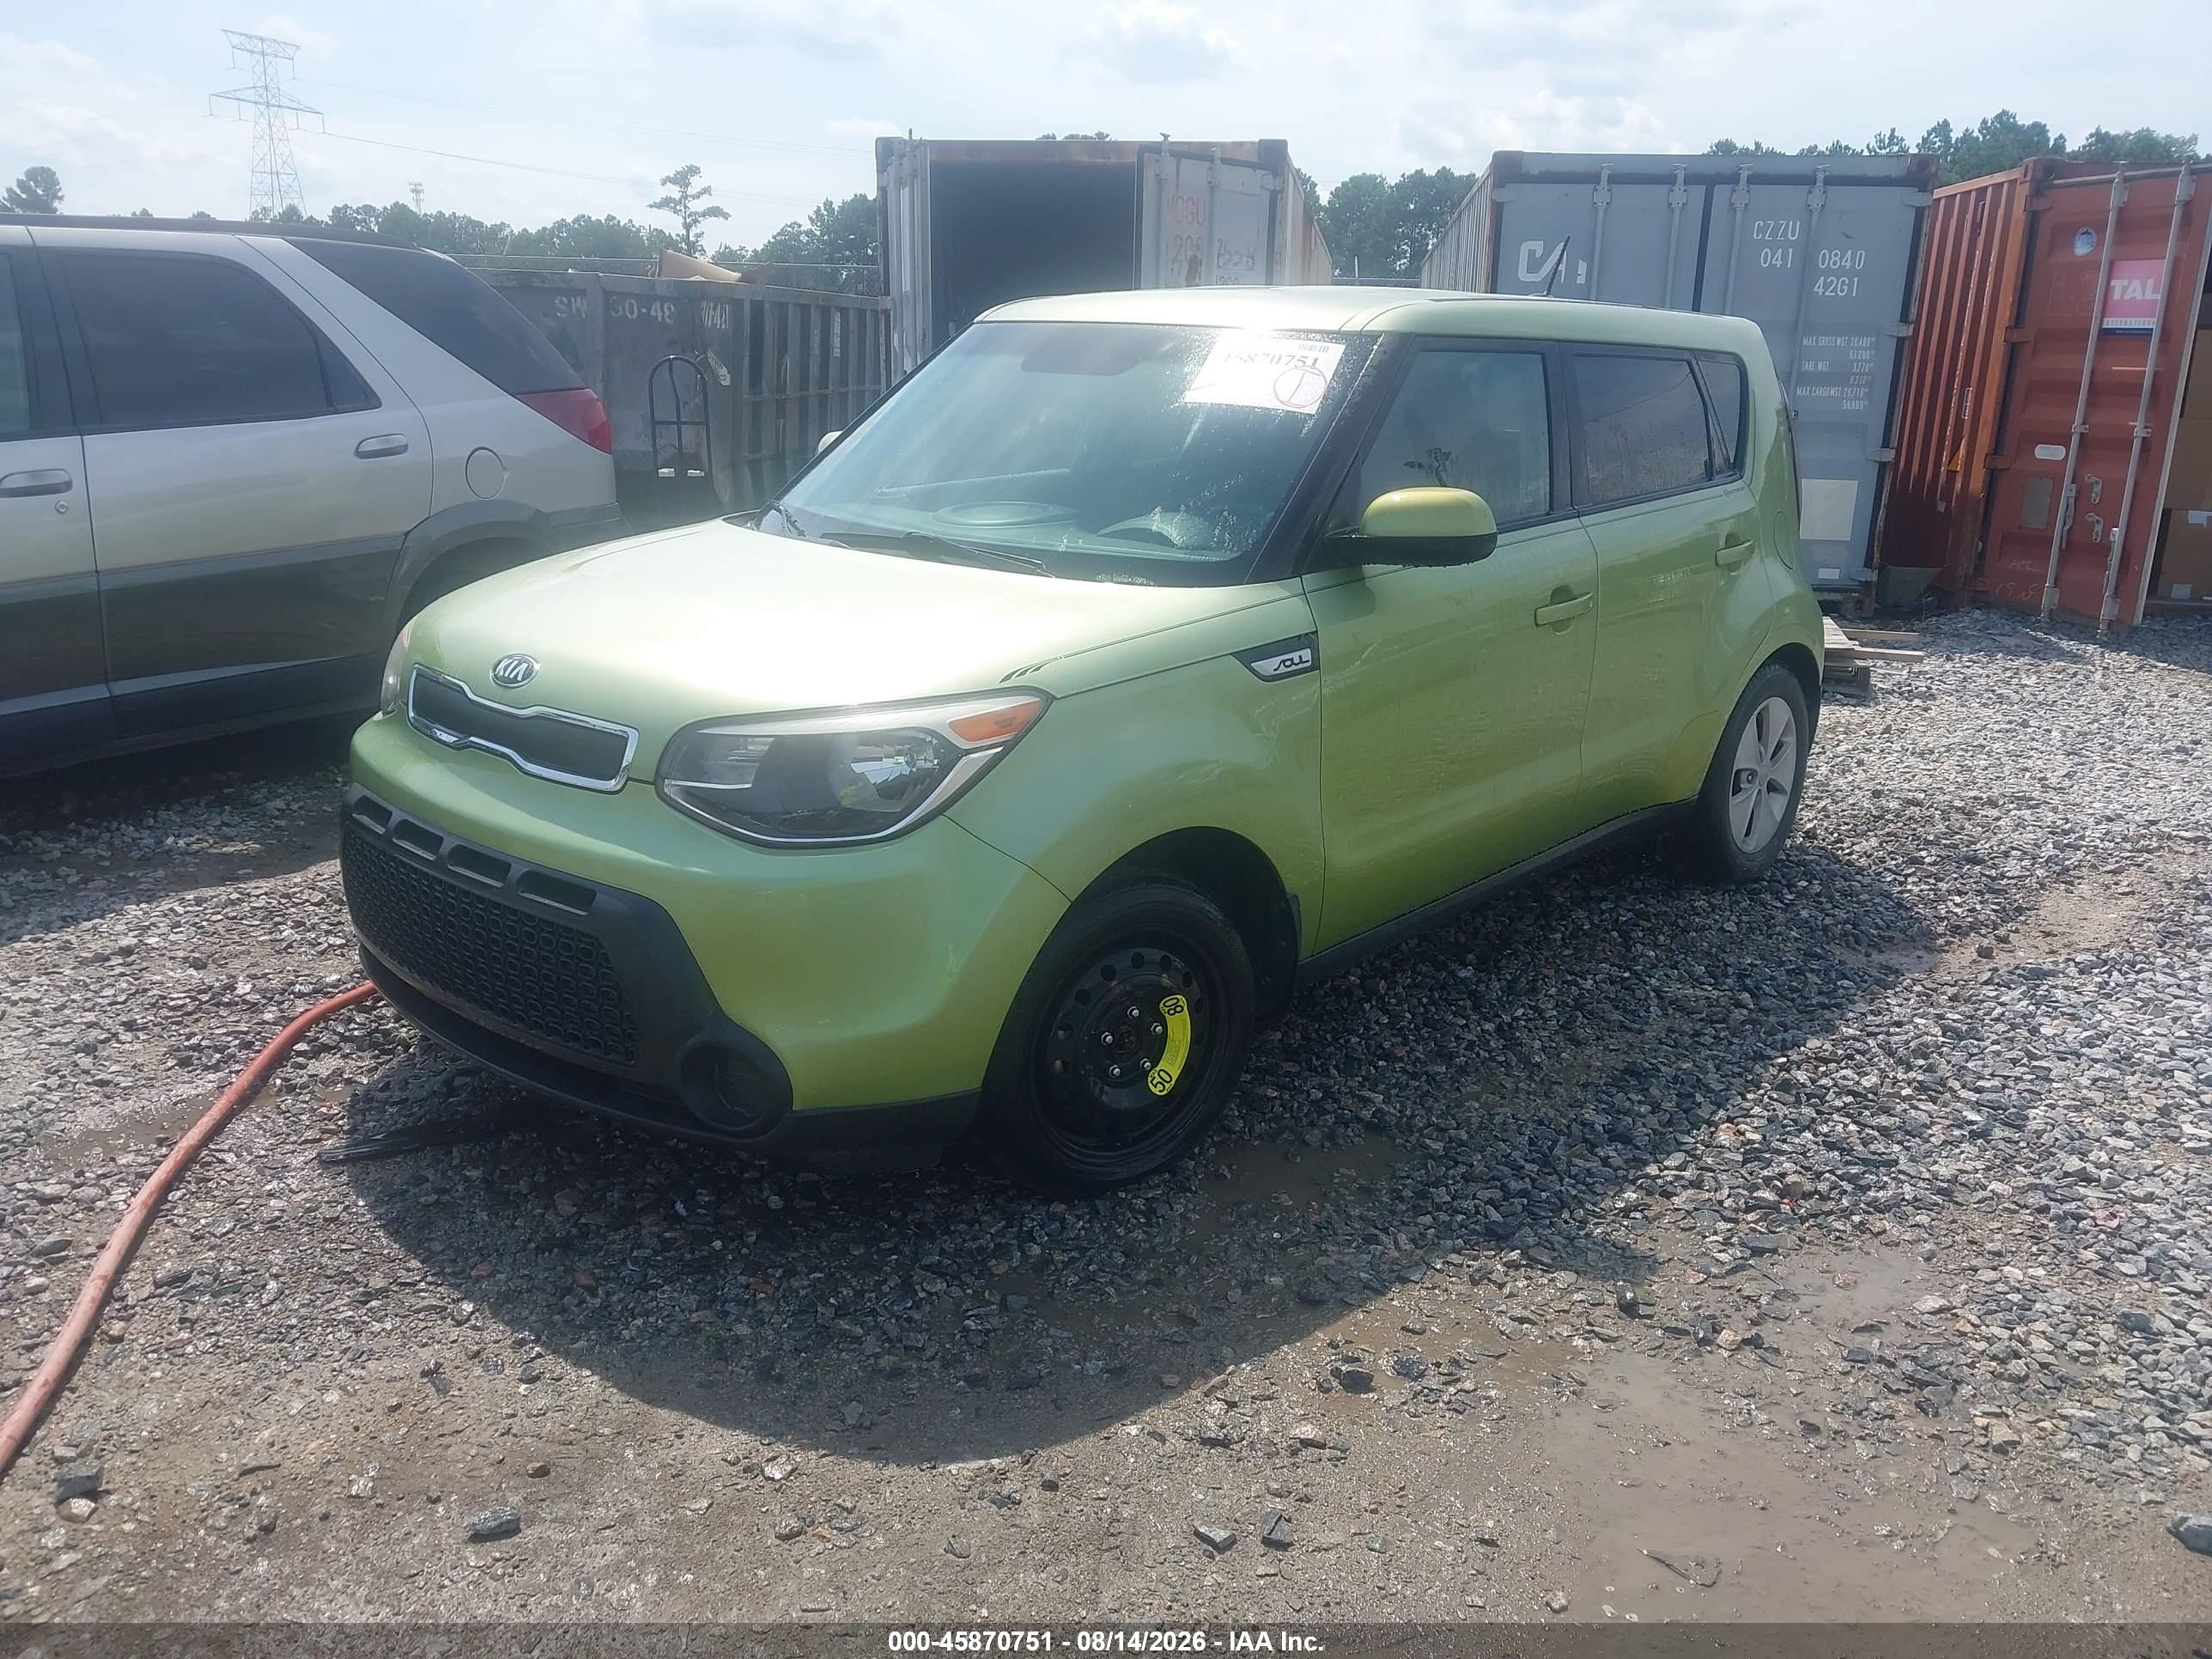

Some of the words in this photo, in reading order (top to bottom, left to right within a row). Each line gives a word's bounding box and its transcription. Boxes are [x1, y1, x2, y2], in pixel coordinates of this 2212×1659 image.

[1753, 220, 1801, 240] CZZU
[1760, 248, 1793, 269] 041
[1818, 249, 1866, 270] 0840
[1813, 276, 1859, 297] 42G1
[2110, 278, 2161, 301] TAL
[554, 295, 589, 319] SW
[495, 658, 529, 682] KIA
[1273, 654, 1310, 672] SOUL
[1163, 997, 1184, 1016] 80
[1149, 1068, 1174, 1093] 50
